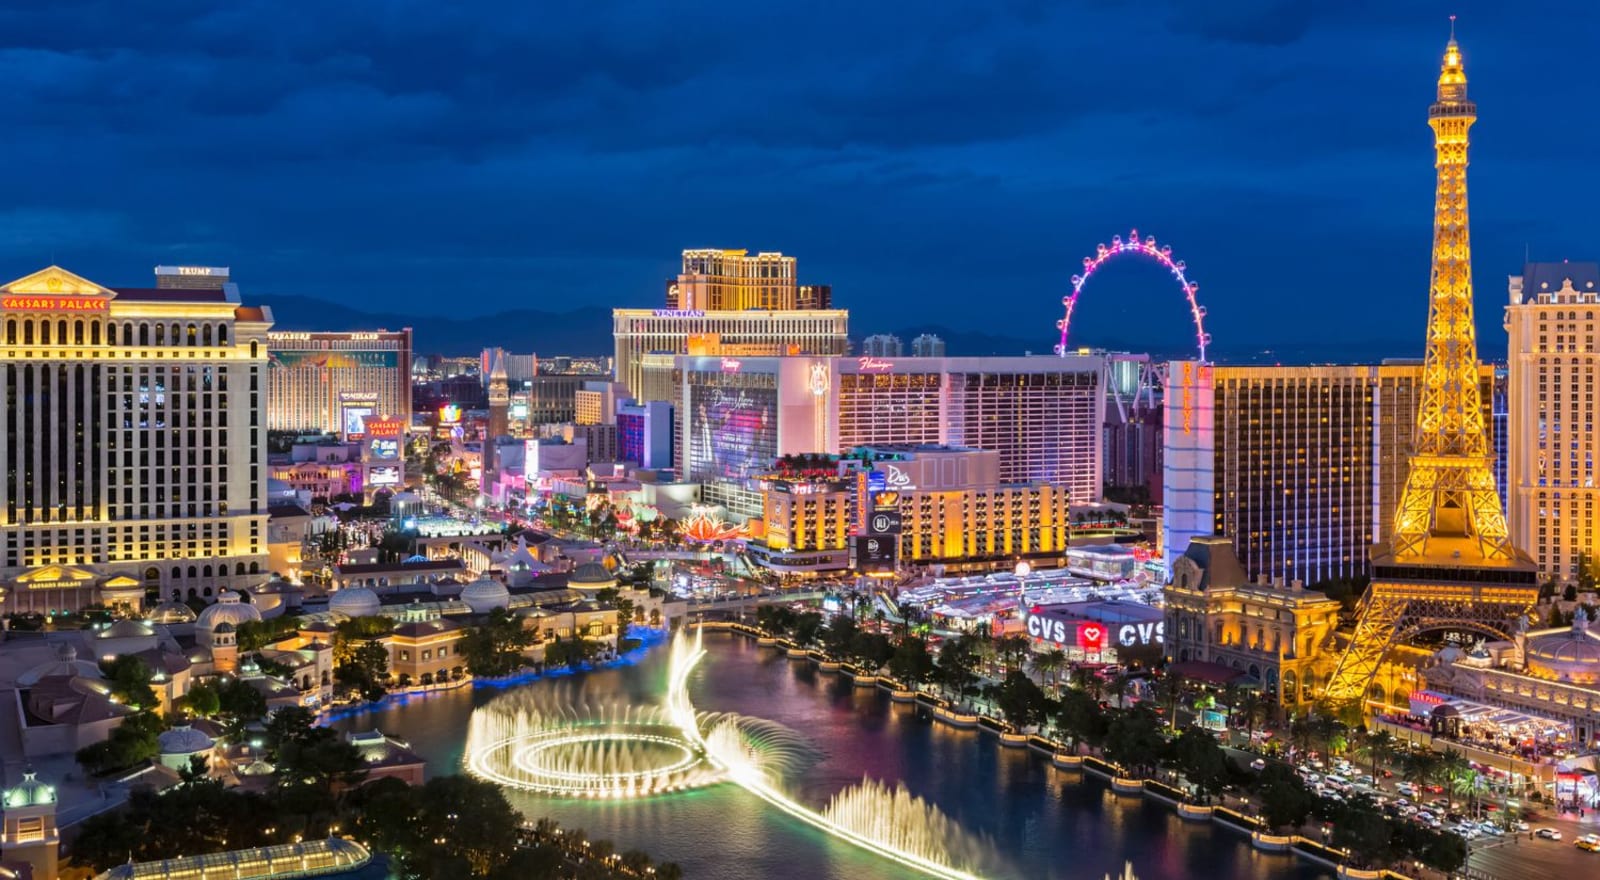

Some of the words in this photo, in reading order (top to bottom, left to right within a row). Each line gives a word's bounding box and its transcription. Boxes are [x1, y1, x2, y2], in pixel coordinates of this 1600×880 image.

[178, 267, 211, 276] TRUMP
[2, 299, 55, 309] CAESARS
[60, 300, 105, 309] PALACE
[655, 309, 703, 318] VENETIAN
[859, 356, 894, 371] Flamingo
[1027, 614, 1066, 643] CVS
[1119, 621, 1164, 647] CVS
